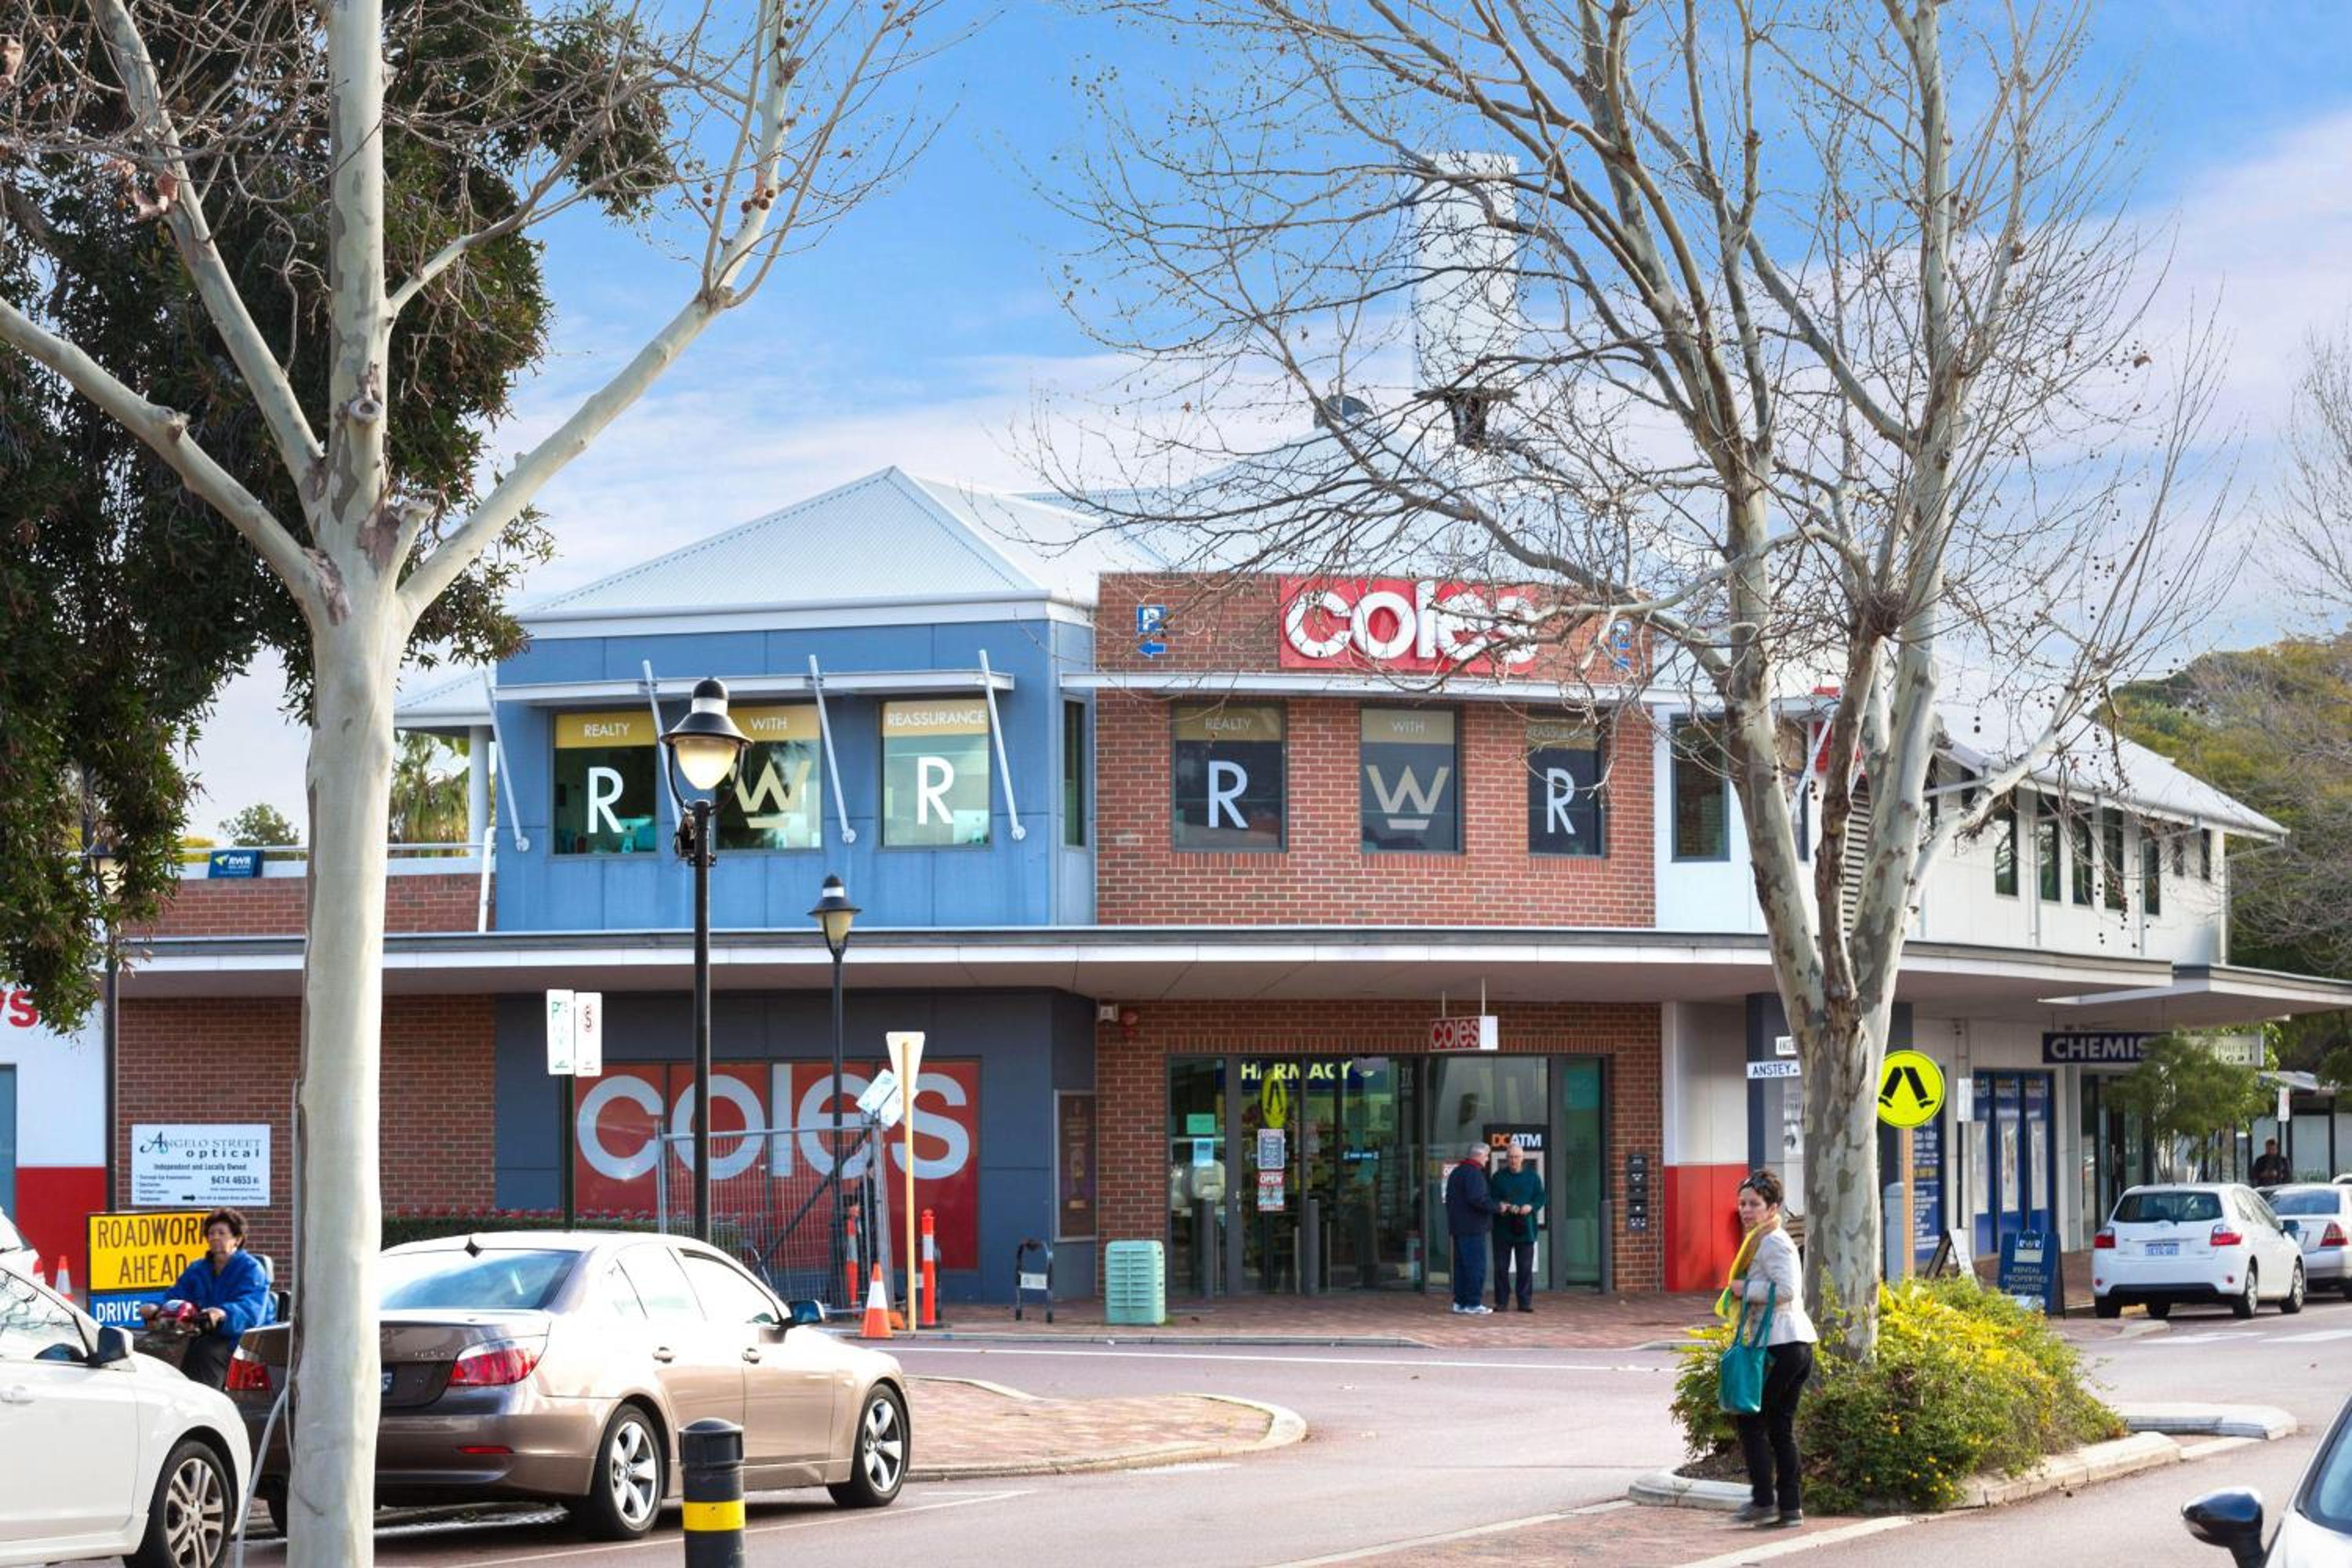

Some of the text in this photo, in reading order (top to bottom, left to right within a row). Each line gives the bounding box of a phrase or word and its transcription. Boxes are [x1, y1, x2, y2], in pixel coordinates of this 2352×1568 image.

[1285, 580, 1538, 664] coles
[583, 722, 630, 738] REALTY
[750, 717, 789, 731] WITH
[887, 709, 985, 727] REASSURANCE
[1204, 717, 1252, 730] REALTY
[1392, 720, 1426, 732] WITH
[726, 759, 811, 813] W
[917, 756, 954, 826] R
[1207, 760, 1248, 829] R
[1366, 764, 1450, 814] W
[589, 766, 625, 833] R
[1547, 768, 1576, 835] R
[1432, 1019, 1480, 1048] coles
[2050, 1036, 2151, 1058] CHEMIS
[1752, 1063, 1791, 1077] ANSTEY
[576, 1063, 970, 1180] coles
[140, 1131, 261, 1154] ANGELO STREET
[186, 1148, 260, 1159] optical
[118, 1254, 187, 1284] AHEAD
[96, 1301, 142, 1323] DRIVE
